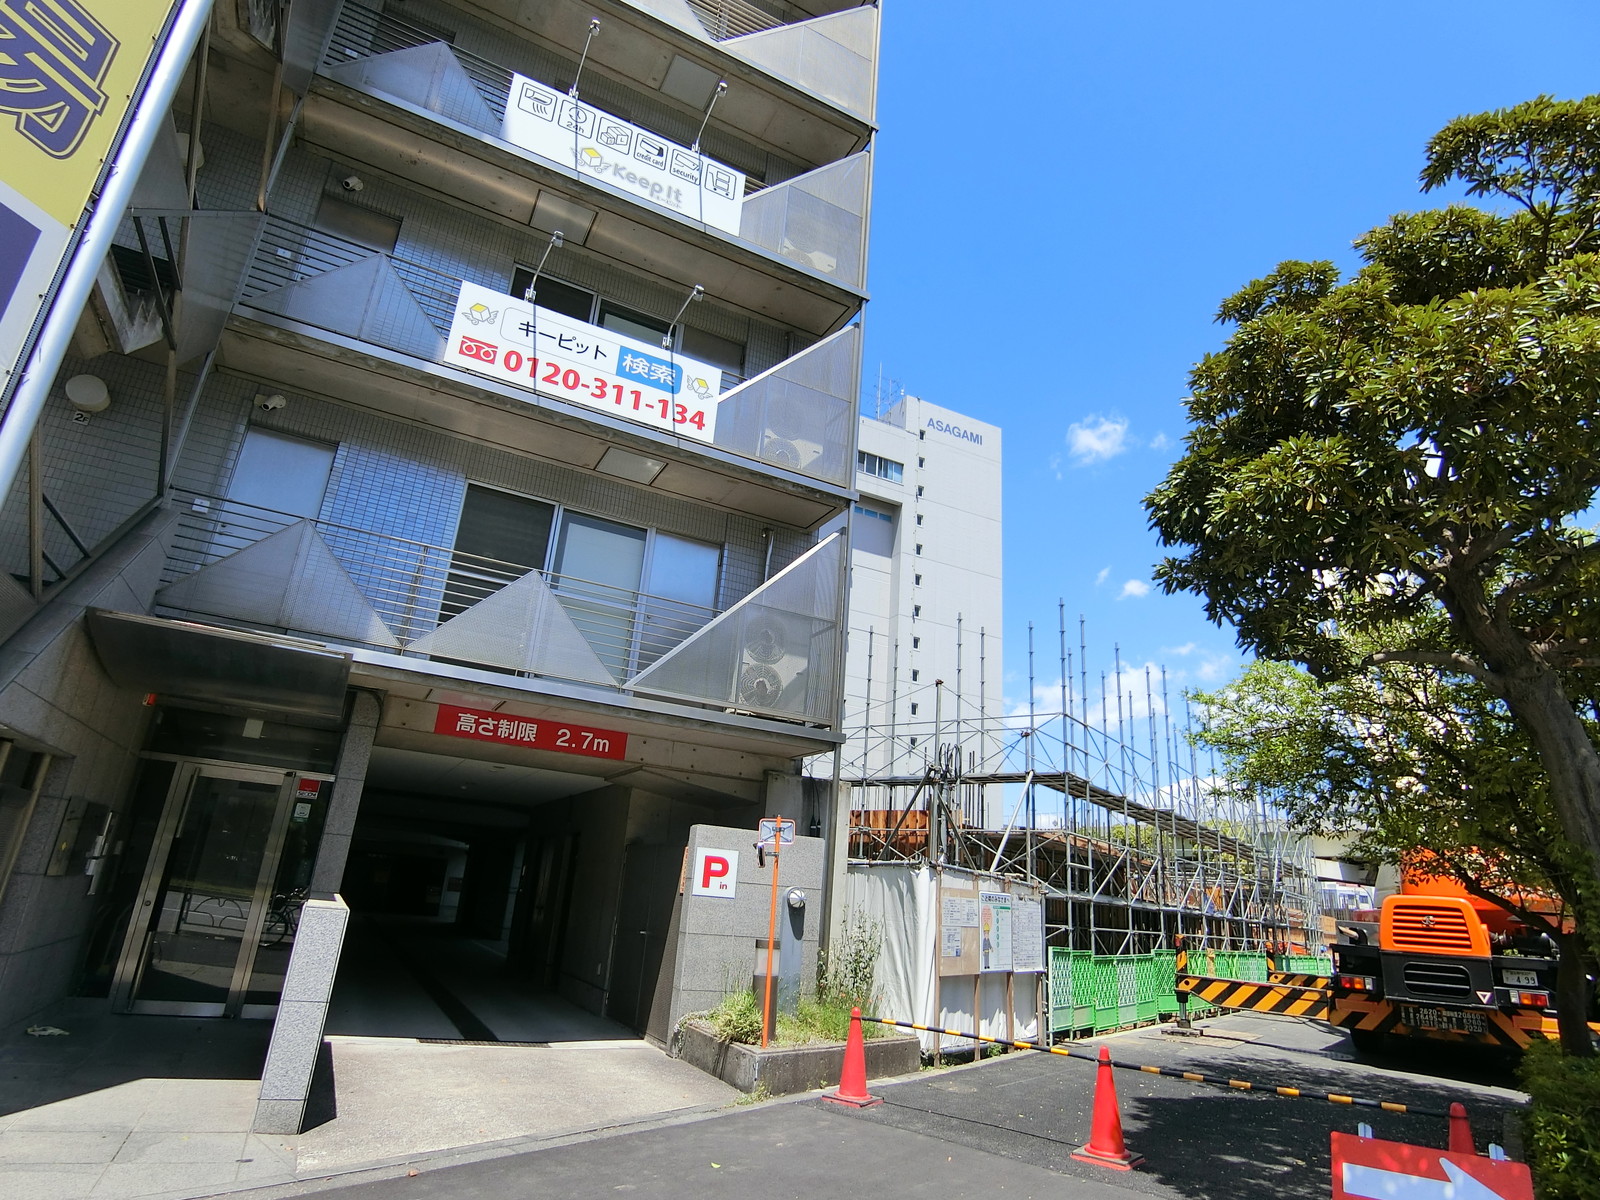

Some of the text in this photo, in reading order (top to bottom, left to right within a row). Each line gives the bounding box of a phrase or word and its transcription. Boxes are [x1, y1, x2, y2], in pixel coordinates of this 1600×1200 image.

[636, 151, 664, 168] credit card
[672, 167, 699, 184] security
[518, 320, 677, 387] キーピット 検索
[503, 350, 706, 431] 0120-311-134
[927, 417, 983, 446] ASAGAMI
[455, 712, 610, 753] 高さ制限 2.7m
[702, 855, 730, 889] P
[719, 882, 728, 890] in
